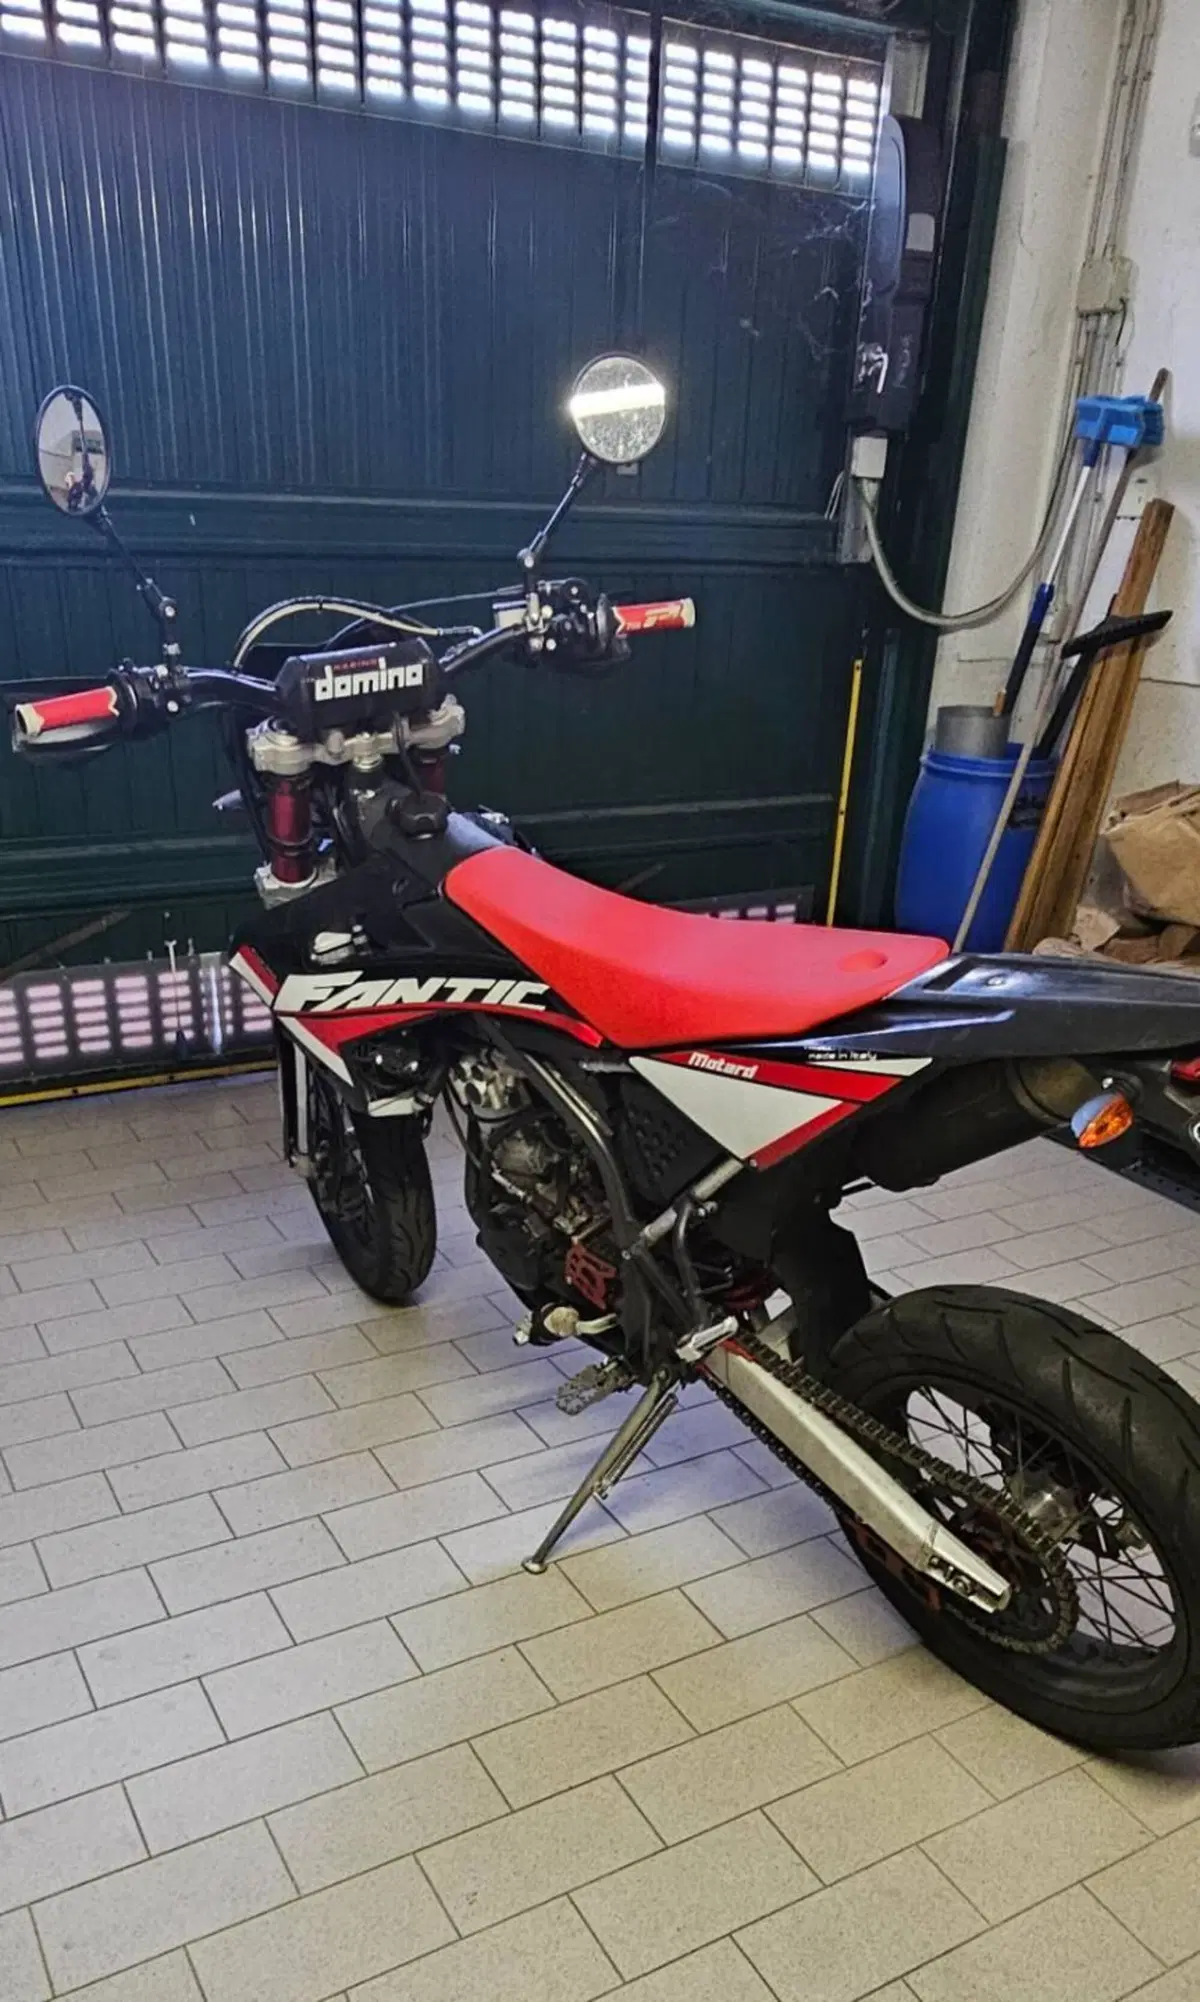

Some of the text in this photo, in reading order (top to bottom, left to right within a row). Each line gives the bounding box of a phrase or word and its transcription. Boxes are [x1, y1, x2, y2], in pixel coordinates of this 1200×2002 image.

[315, 656, 423, 701] domino
[273, 970, 550, 1012] FANTIC
[688, 1051, 760, 1079] Motard
[807, 1051, 836, 1061] made
